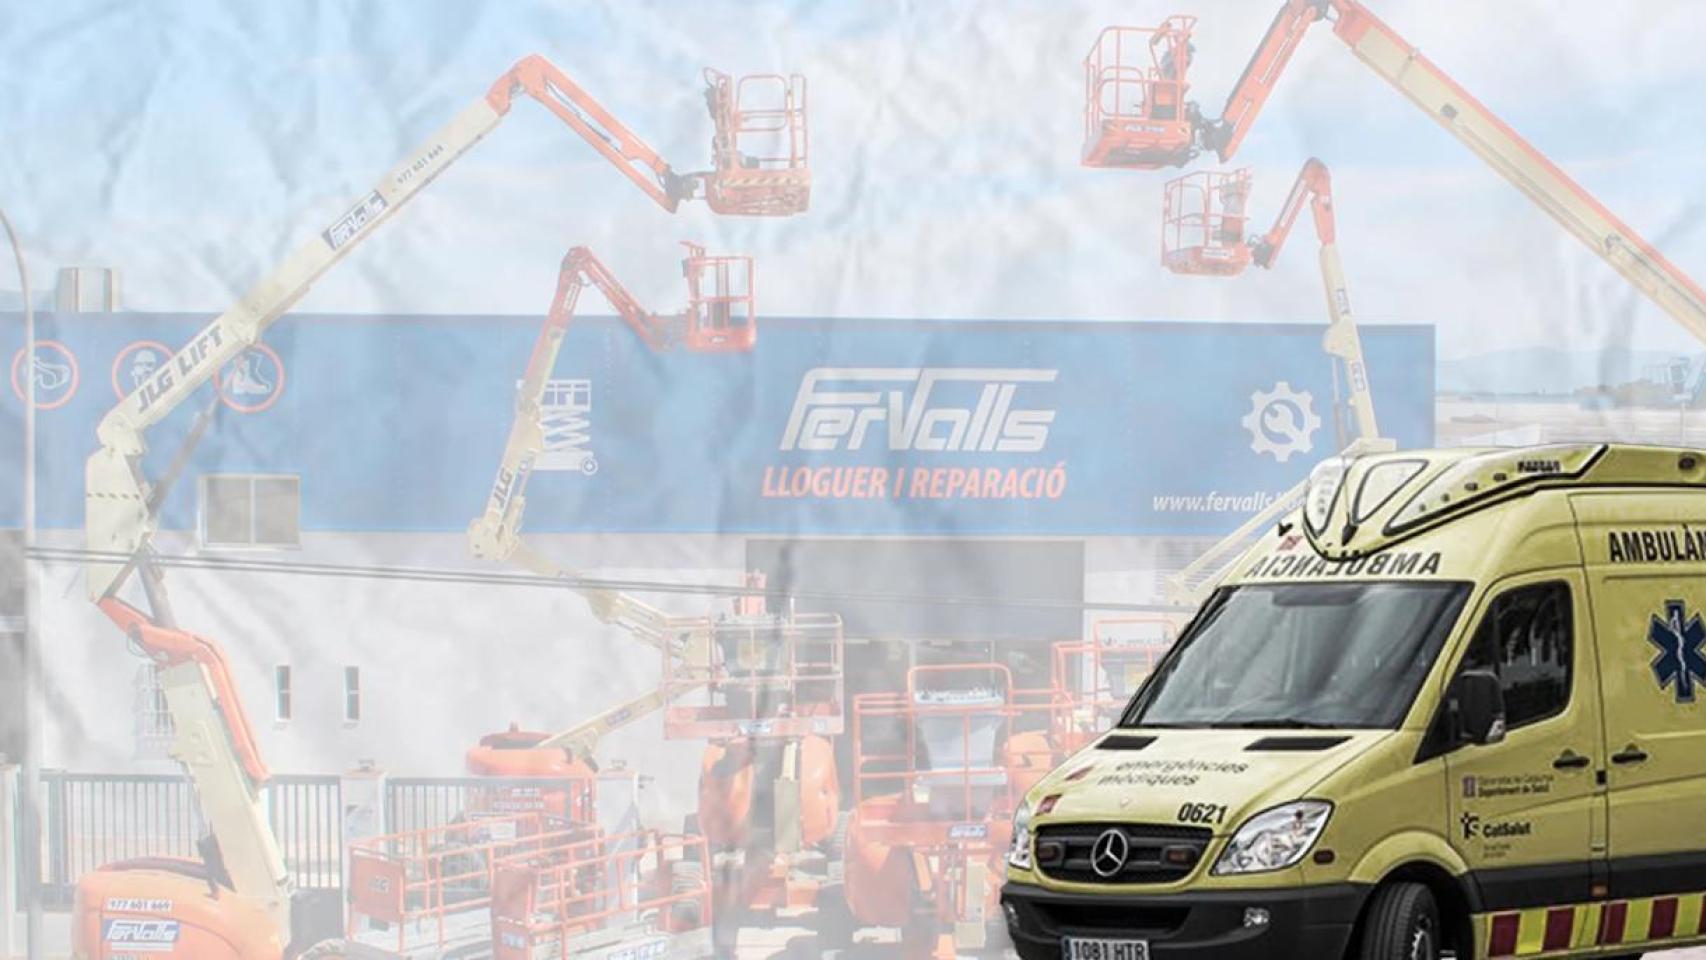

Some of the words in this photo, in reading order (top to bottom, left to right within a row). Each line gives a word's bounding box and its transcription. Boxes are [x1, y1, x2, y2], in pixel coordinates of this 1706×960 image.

[138, 367, 174, 414] JLG
[177, 325, 223, 377] LIFT
[493, 468, 512, 509] JLG
[762, 466, 889, 498] LLOGUER
[892, 467, 904, 498] I
[909, 460, 1067, 499] REPARACIÓ
[1177, 802, 1227, 824] 0621
[1482, 822, 1531, 838] CatSalut
[1074, 941, 1108, 960] 1081
[1114, 942, 1145, 960] HTR
